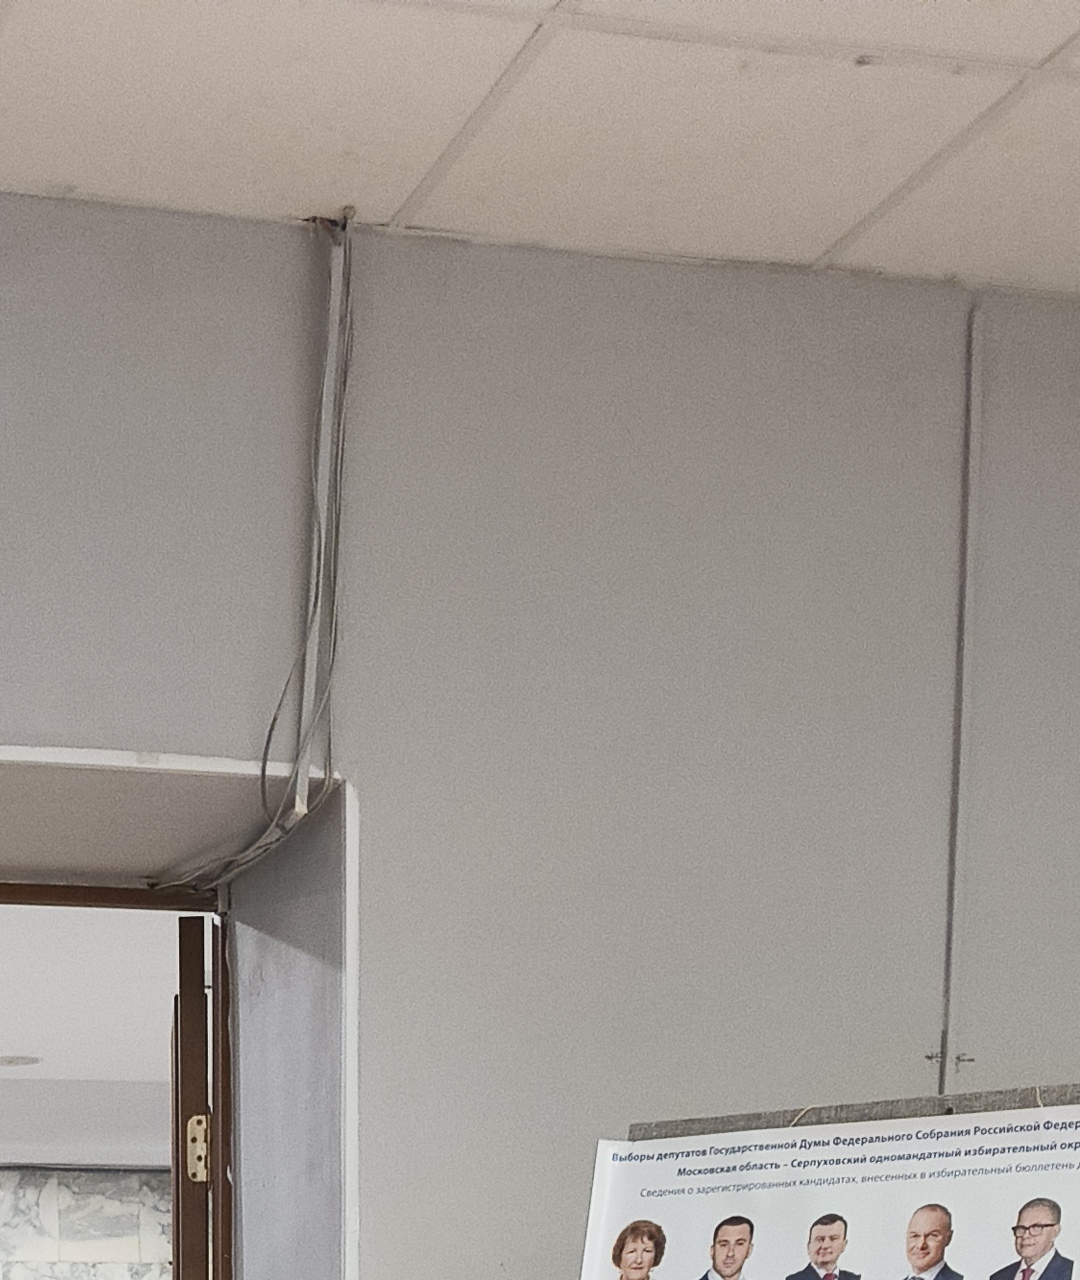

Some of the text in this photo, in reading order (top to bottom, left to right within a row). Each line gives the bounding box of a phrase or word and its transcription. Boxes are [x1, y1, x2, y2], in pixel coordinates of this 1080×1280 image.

[612, 1152, 655, 1163] Выборы
[656, 1149, 707, 1162] депутатов
[709, 1139, 797, 1156] Государственной
[798, 1139, 831, 1150] Думы
[832, 1133, 913, 1147] Федерального
[915, 1128, 971, 1141] Собрания
[973, 1121, 1041, 1136] Российской
[677, 1165, 737, 1177] Московская
[738, 1161, 781, 1172] область
[790, 1154, 867, 1170] Серпуховский
[869, 1148, 962, 1164] одномандатный
[964, 1140, 1058, 1157] избирательный
[640, 1187, 686, 1198] Сведения
[695, 1179, 798, 1195] зарегистрированных
[799, 1176, 859, 1187] кандидатах,
[861, 1173, 918, 1183] внесенных
[928, 1164, 1013, 1179] избирательный
[1015, 1162, 1075, 1173] бюллетень
